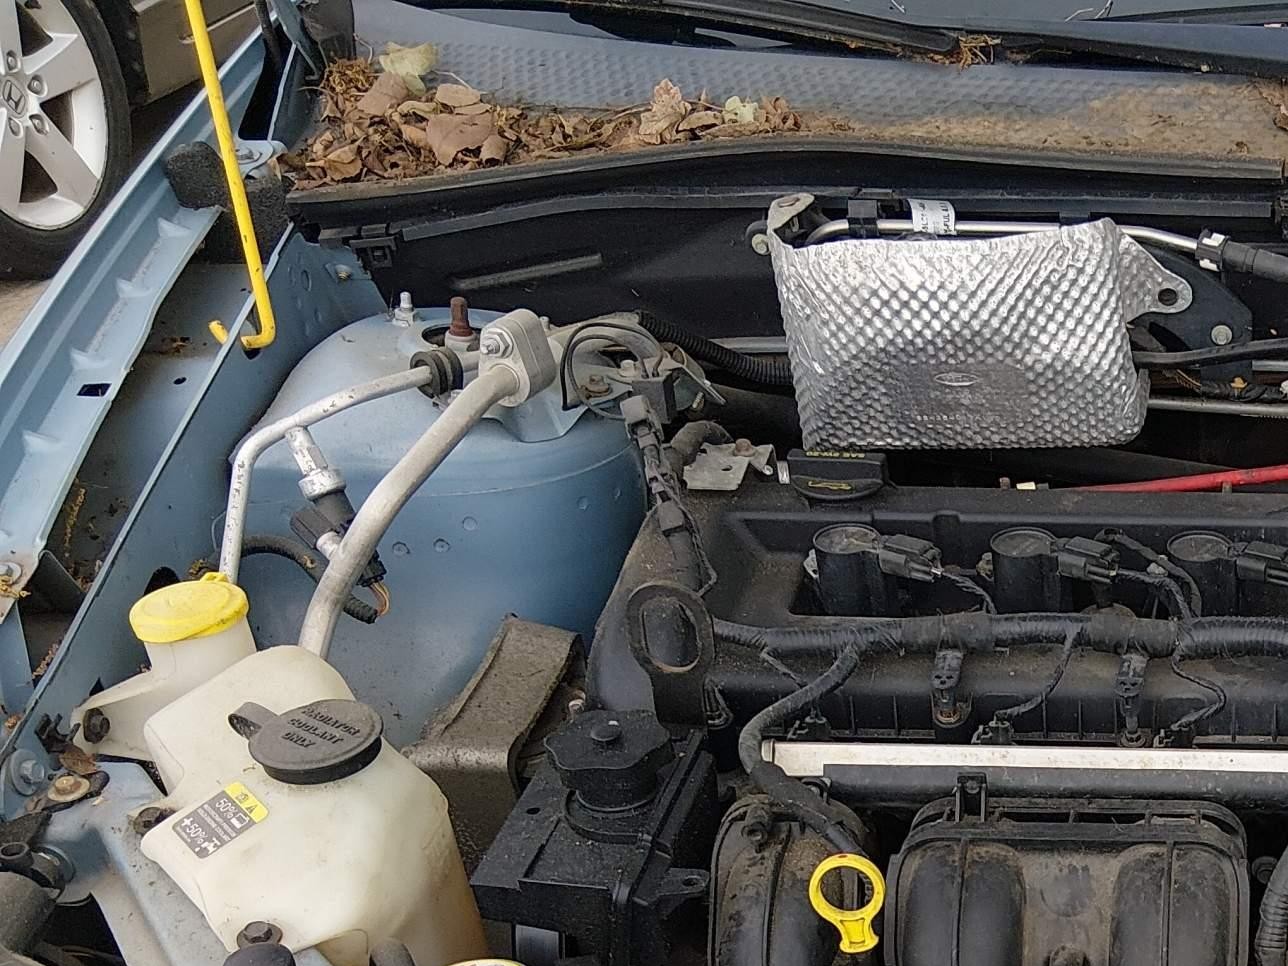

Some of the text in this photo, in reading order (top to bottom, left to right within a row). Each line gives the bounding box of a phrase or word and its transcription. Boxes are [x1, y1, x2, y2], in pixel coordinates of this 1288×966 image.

[287, 717, 345, 745] COOLANT
[301, 706, 361, 736] RADIATOR
[281, 731, 317, 748] ONLY
[215, 798, 239, 818] 50%
